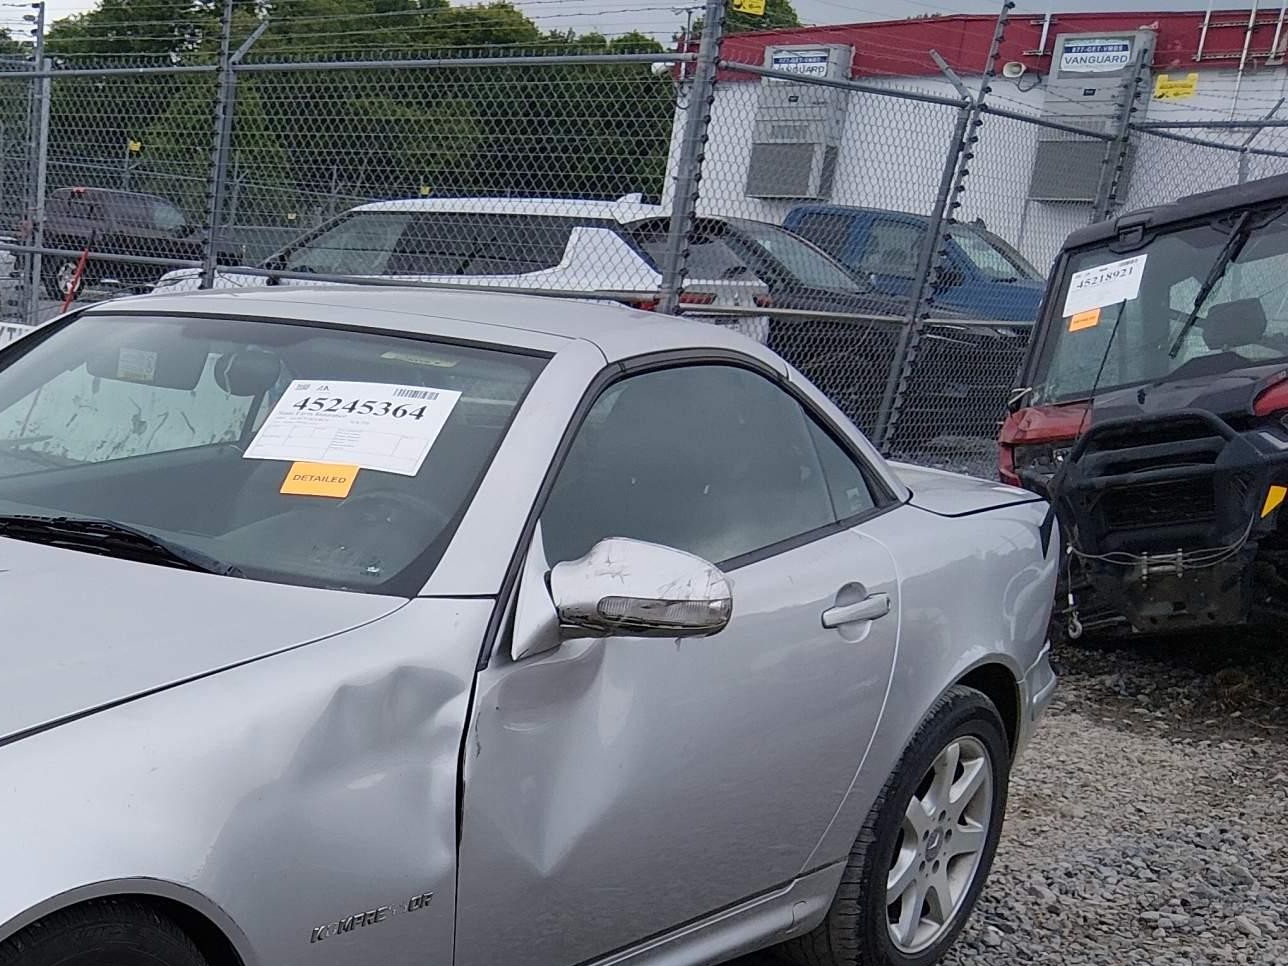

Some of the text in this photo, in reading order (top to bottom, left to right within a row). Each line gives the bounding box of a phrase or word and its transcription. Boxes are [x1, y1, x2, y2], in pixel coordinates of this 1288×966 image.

[1064, 55, 1128, 65] VANGUARD
[1076, 266, 1133, 289] 45218921
[293, 396, 428, 421] 45245364
[292, 473, 347, 485] DETAILED
